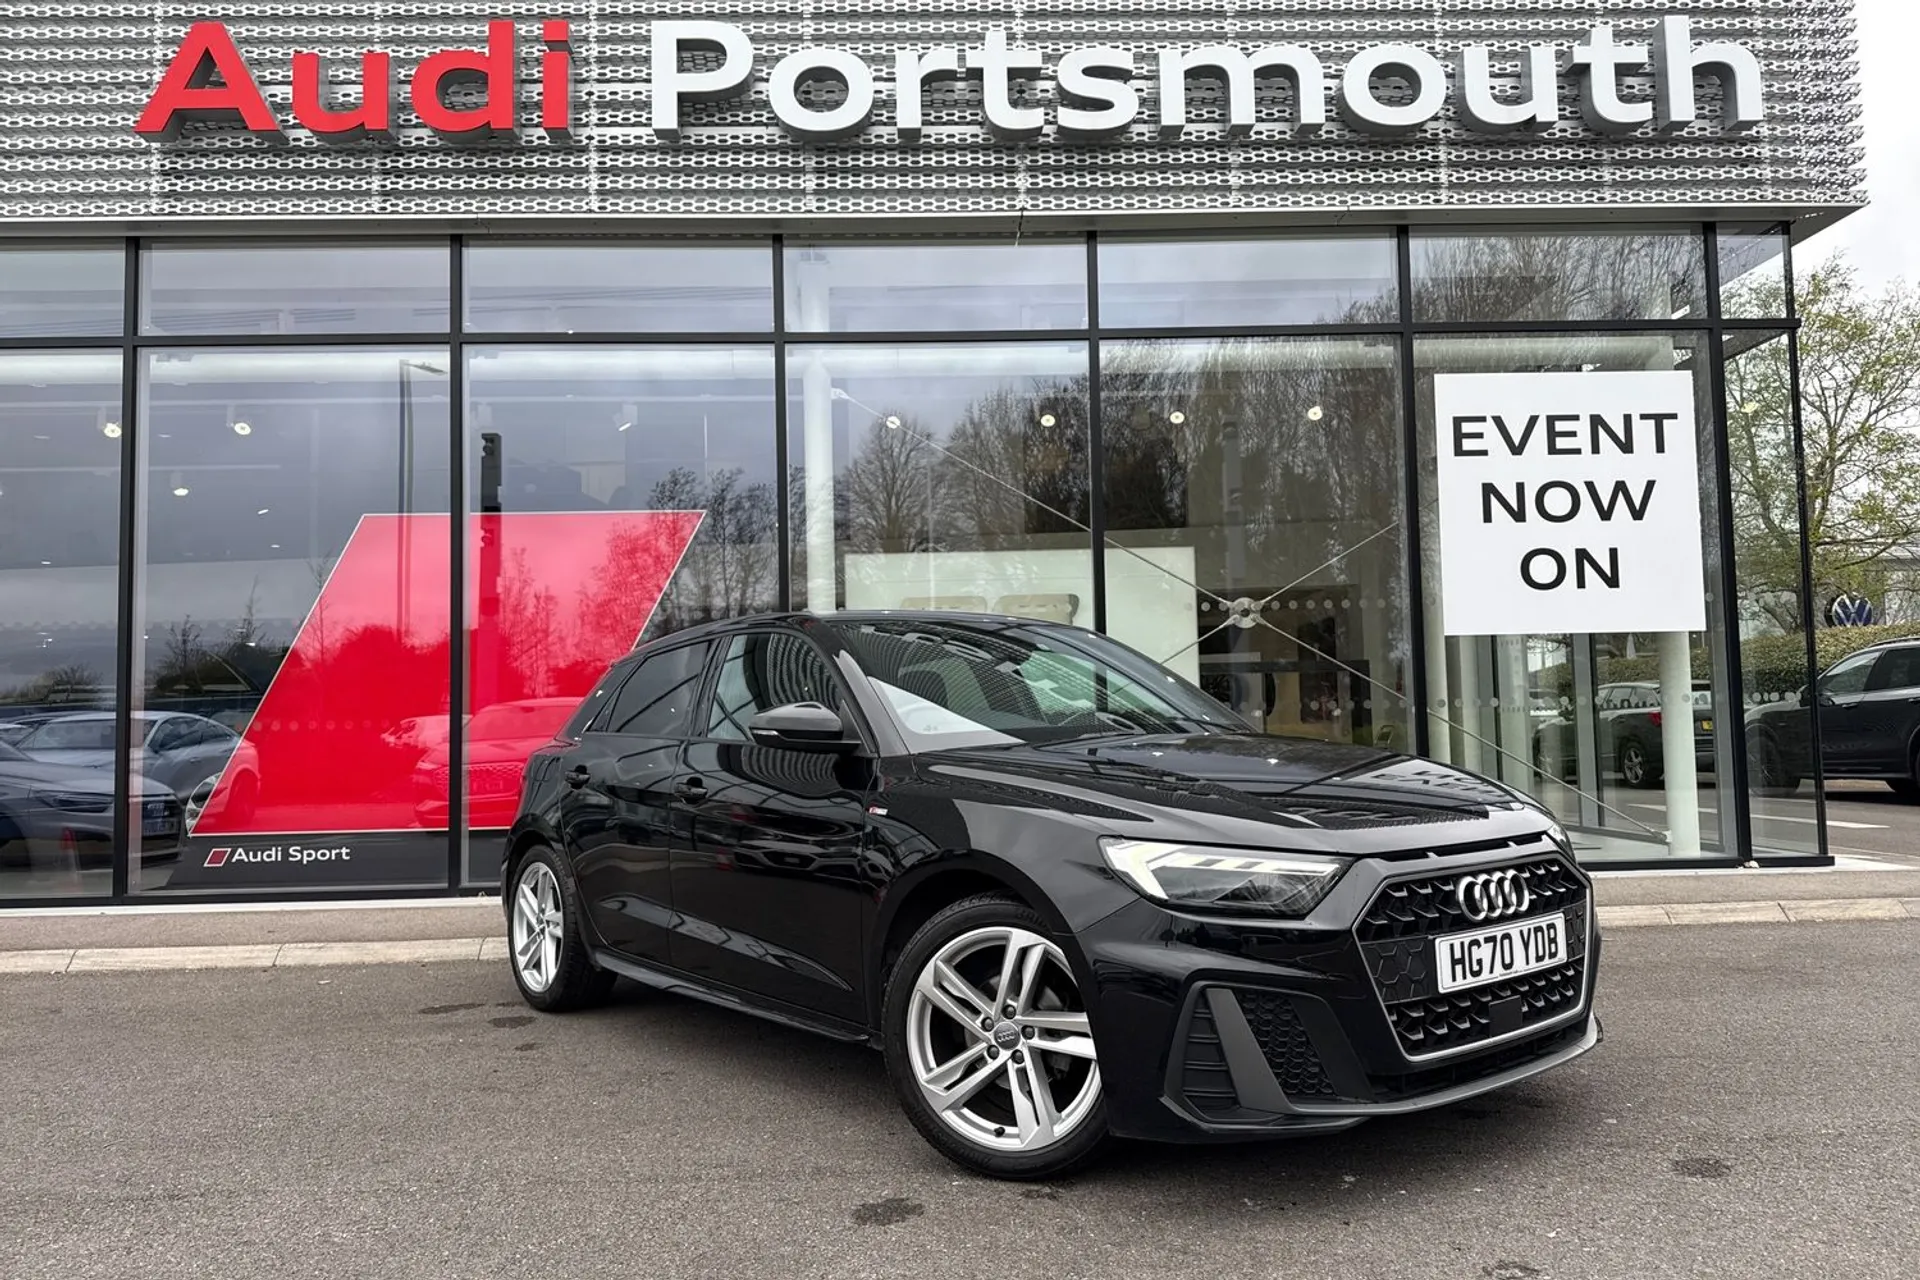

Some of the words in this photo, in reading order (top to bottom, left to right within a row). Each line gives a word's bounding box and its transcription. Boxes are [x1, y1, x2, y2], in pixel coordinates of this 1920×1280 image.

[135, 20, 572, 135] Audi
[650, 15, 1763, 133] Portsmouth
[1452, 413, 1678, 457] EVENT
[1481, 479, 1656, 524] NOW
[1520, 547, 1620, 591] ON
[231, 846, 282, 863] Audi
[288, 846, 351, 865] Sport
[1449, 932, 1514, 983] HG70
[1519, 922, 1559, 966] YDB
